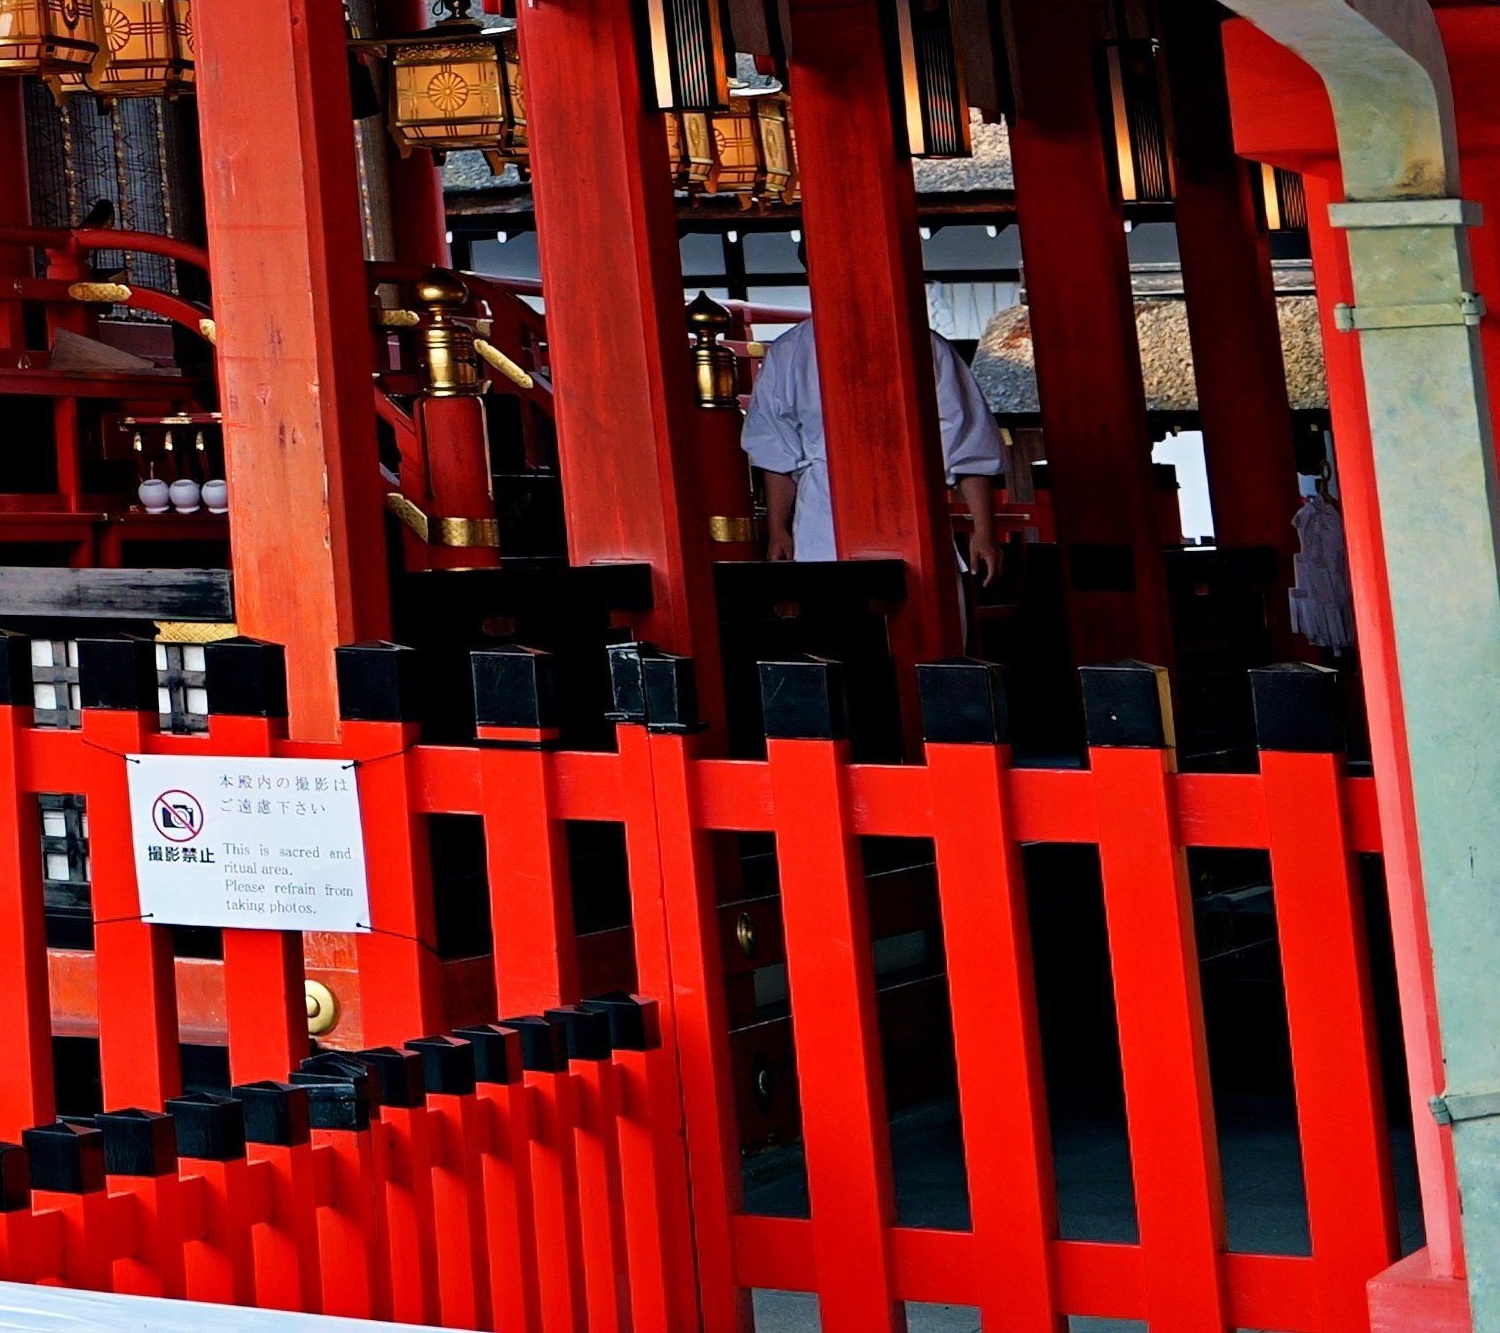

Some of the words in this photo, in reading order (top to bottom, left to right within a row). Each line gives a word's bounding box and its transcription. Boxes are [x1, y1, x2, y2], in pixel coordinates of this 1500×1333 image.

[219, 774, 349, 792] 本殿内の撮影は
[220, 798, 327, 815] ご遠慮下さい
[147, 845, 216, 864] 撮影禁止
[222, 842, 251, 855] This
[259, 844, 270, 856] is
[279, 846, 320, 858] sacred
[329, 847, 352, 859] and
[224, 861, 257, 874] ritual
[261, 865, 293, 876] area.
[225, 879, 266, 893] Please
[274, 882, 316, 895] refrain
[325, 884, 354, 897] from
[226, 898, 265, 913] taking
[270, 900, 317, 914] photos.
